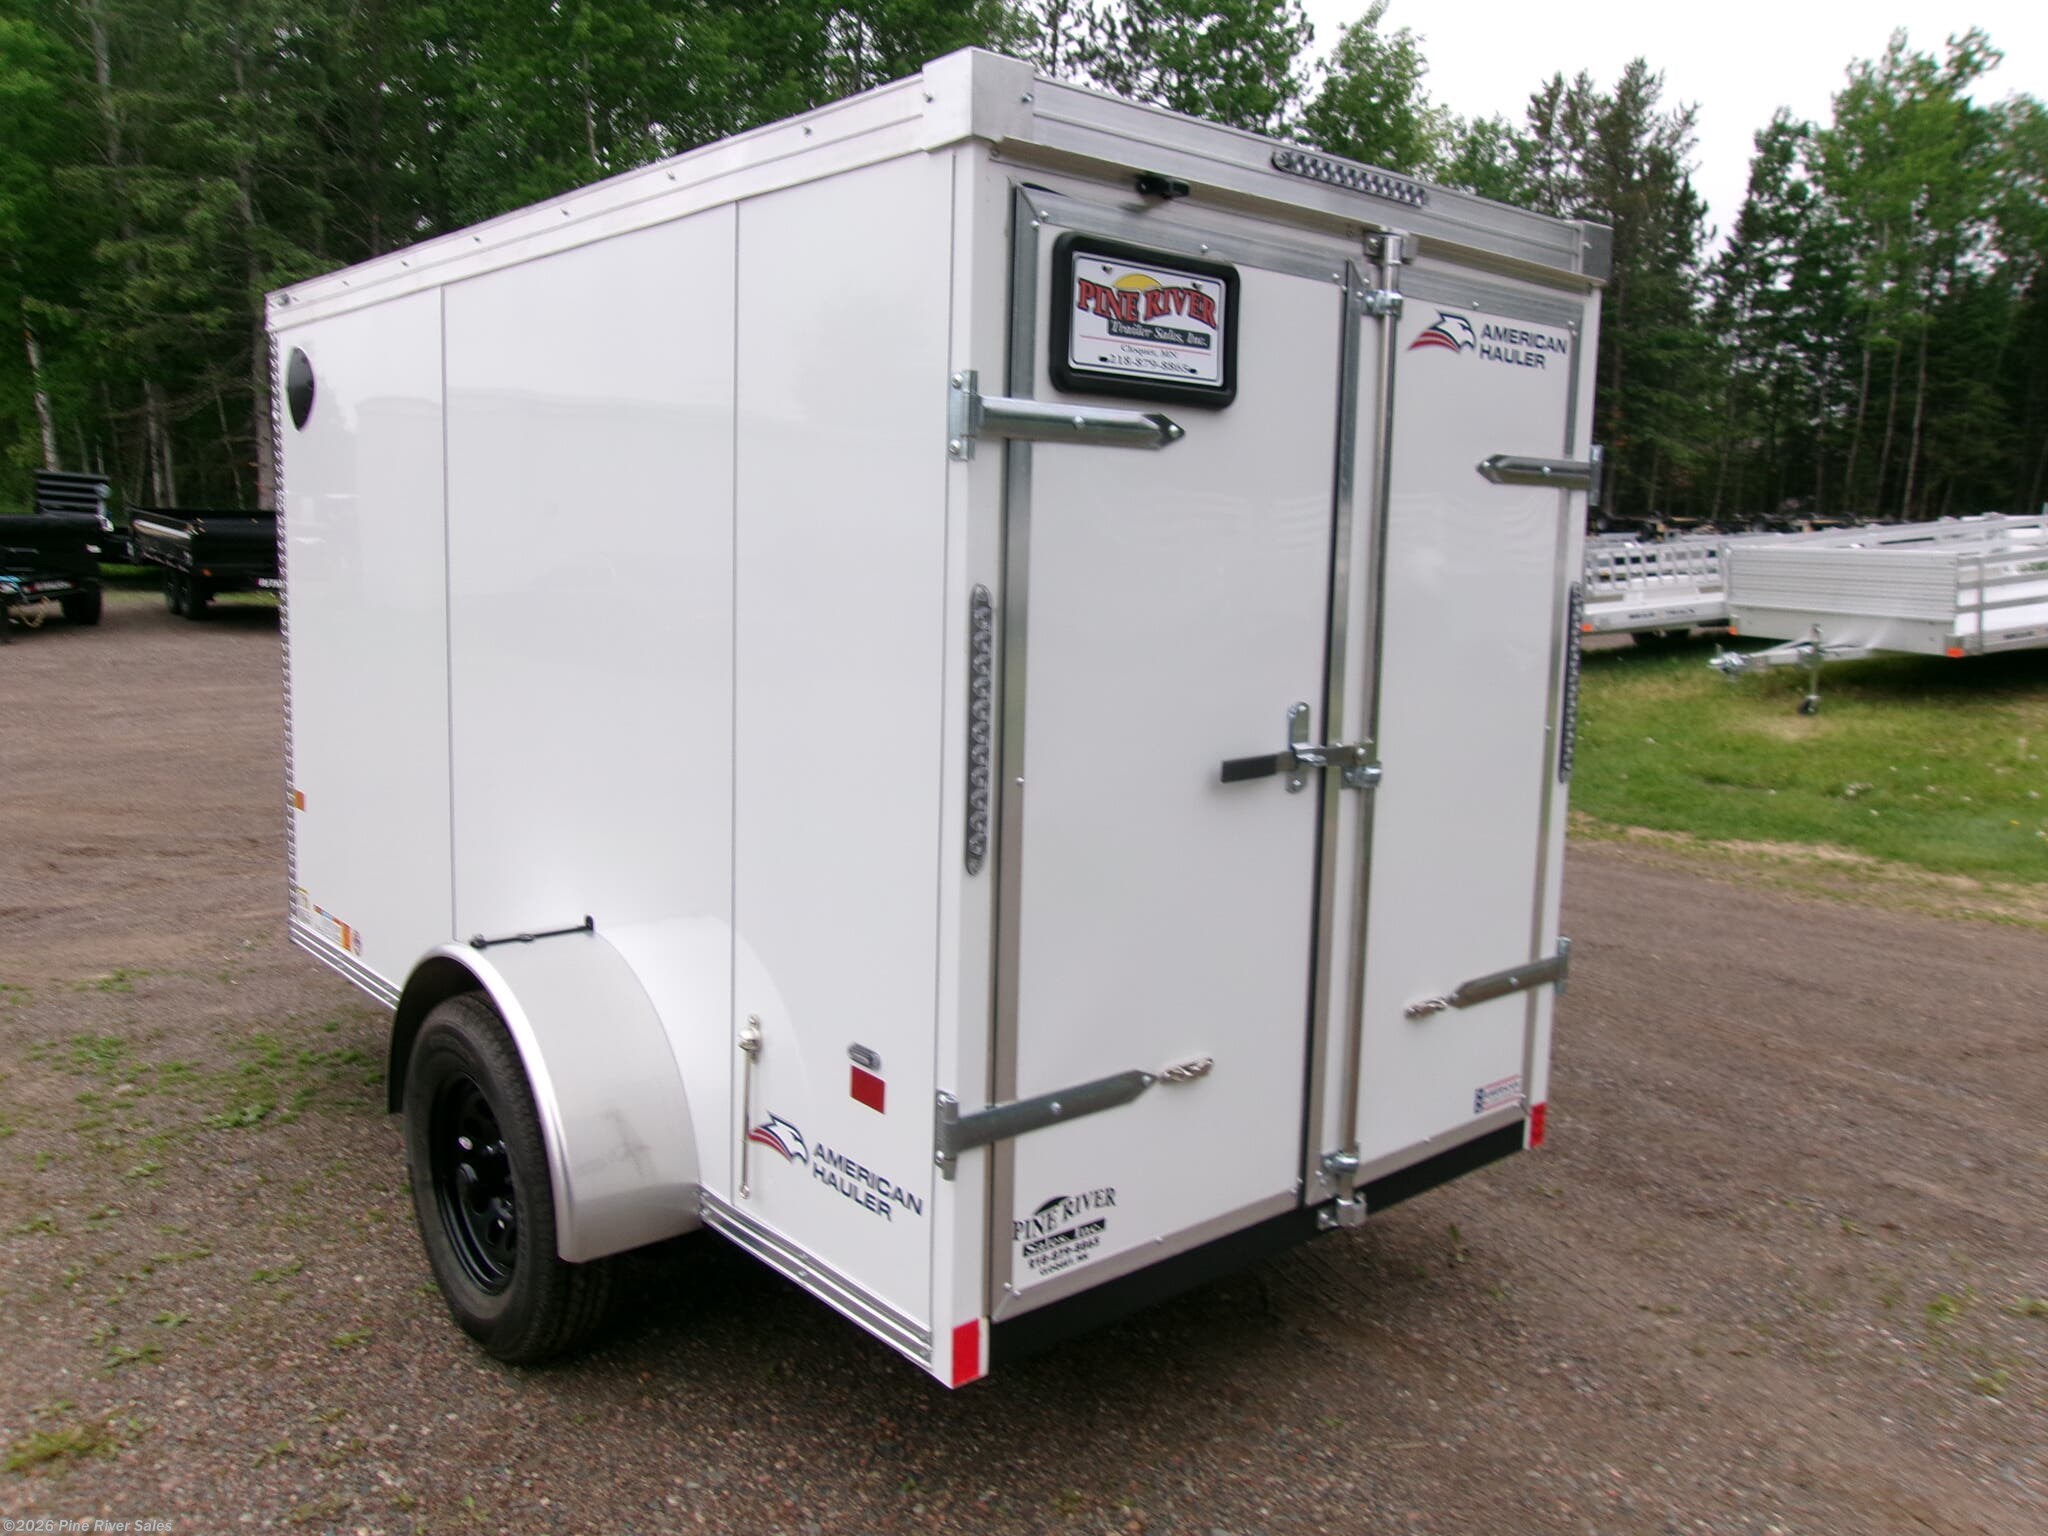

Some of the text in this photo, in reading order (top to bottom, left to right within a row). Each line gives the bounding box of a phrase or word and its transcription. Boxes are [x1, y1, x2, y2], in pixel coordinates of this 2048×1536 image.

[1077, 278, 1217, 330] PINE RIVER
[1479, 343, 1546, 369] HAULER
[1480, 323, 1567, 354] AMERICAN
[812, 1162, 893, 1222] HAULER
[813, 1142, 923, 1216] AMERICAN
[1013, 1209, 1058, 1240] PINE
[1062, 1187, 1117, 1221] RIVER
